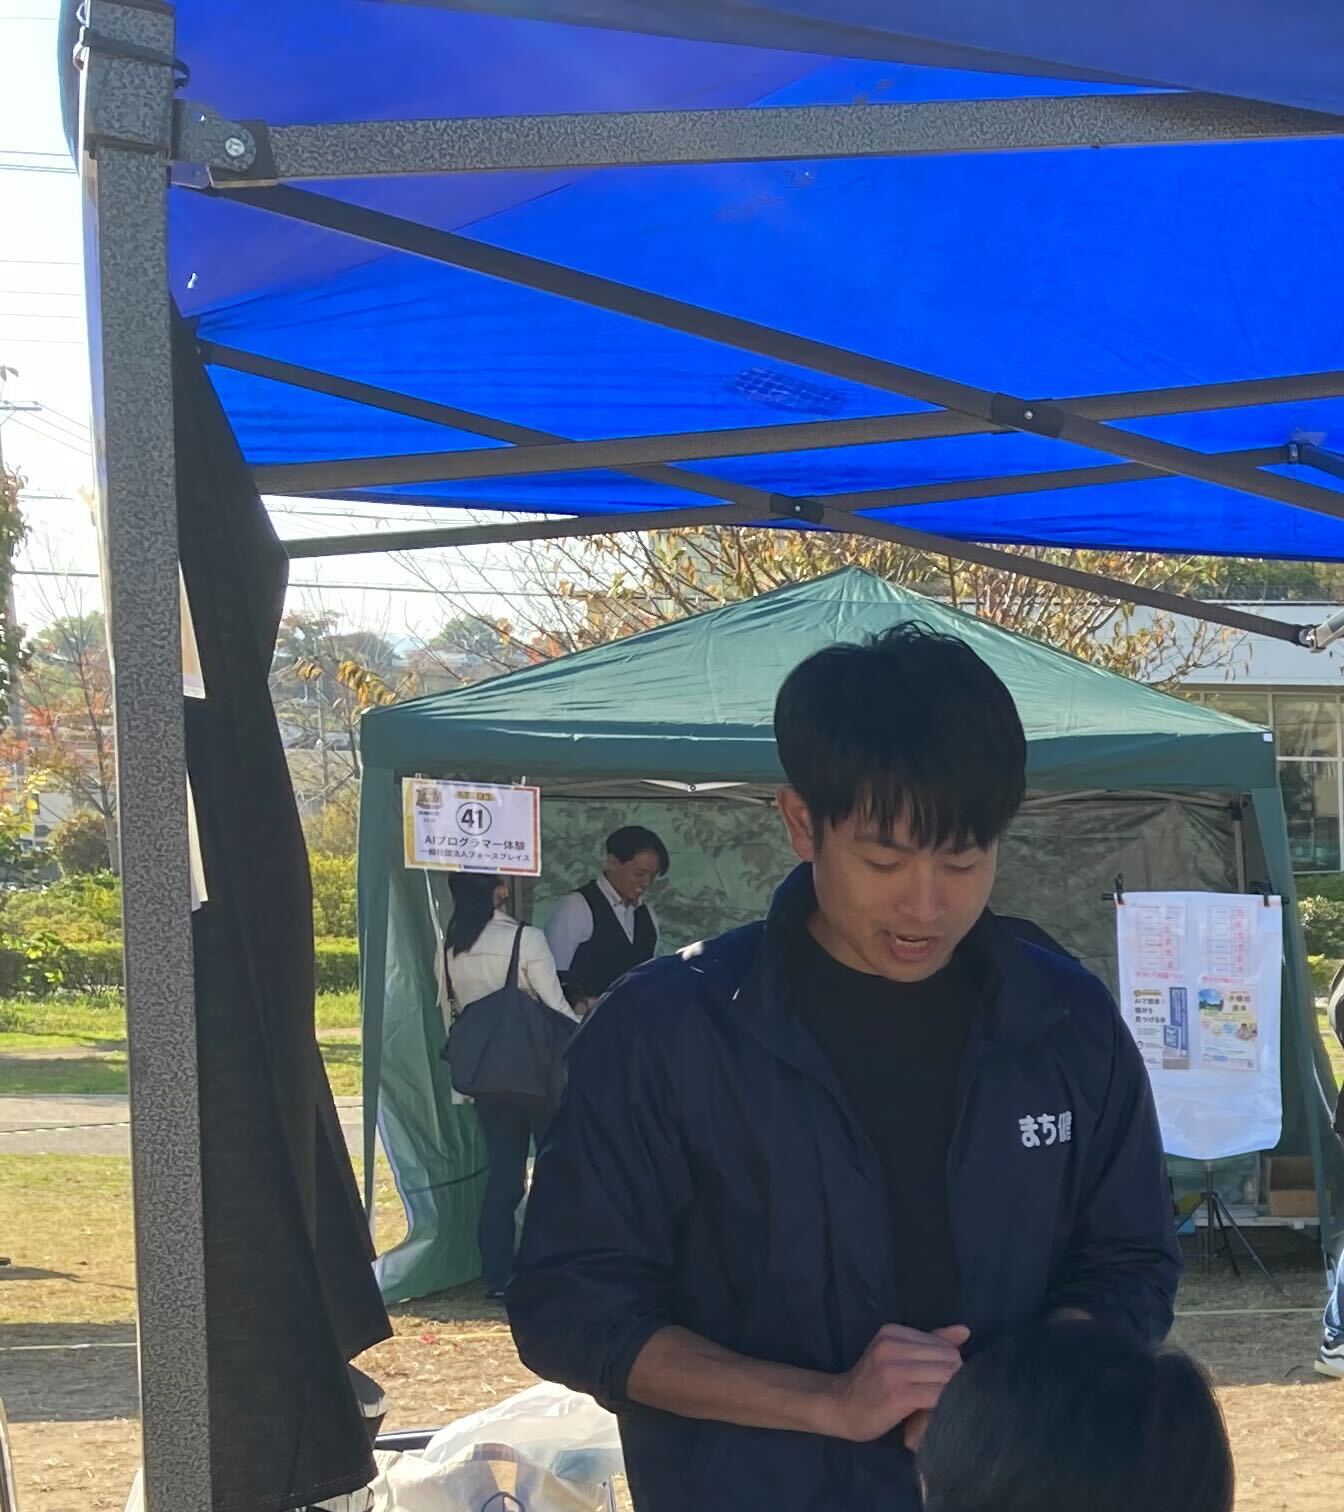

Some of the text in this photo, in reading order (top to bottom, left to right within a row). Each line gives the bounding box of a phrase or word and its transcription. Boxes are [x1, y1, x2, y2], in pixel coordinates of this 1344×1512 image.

[460, 808, 484, 830] 41
[424, 835, 527, 851] AIプログラマー体験
